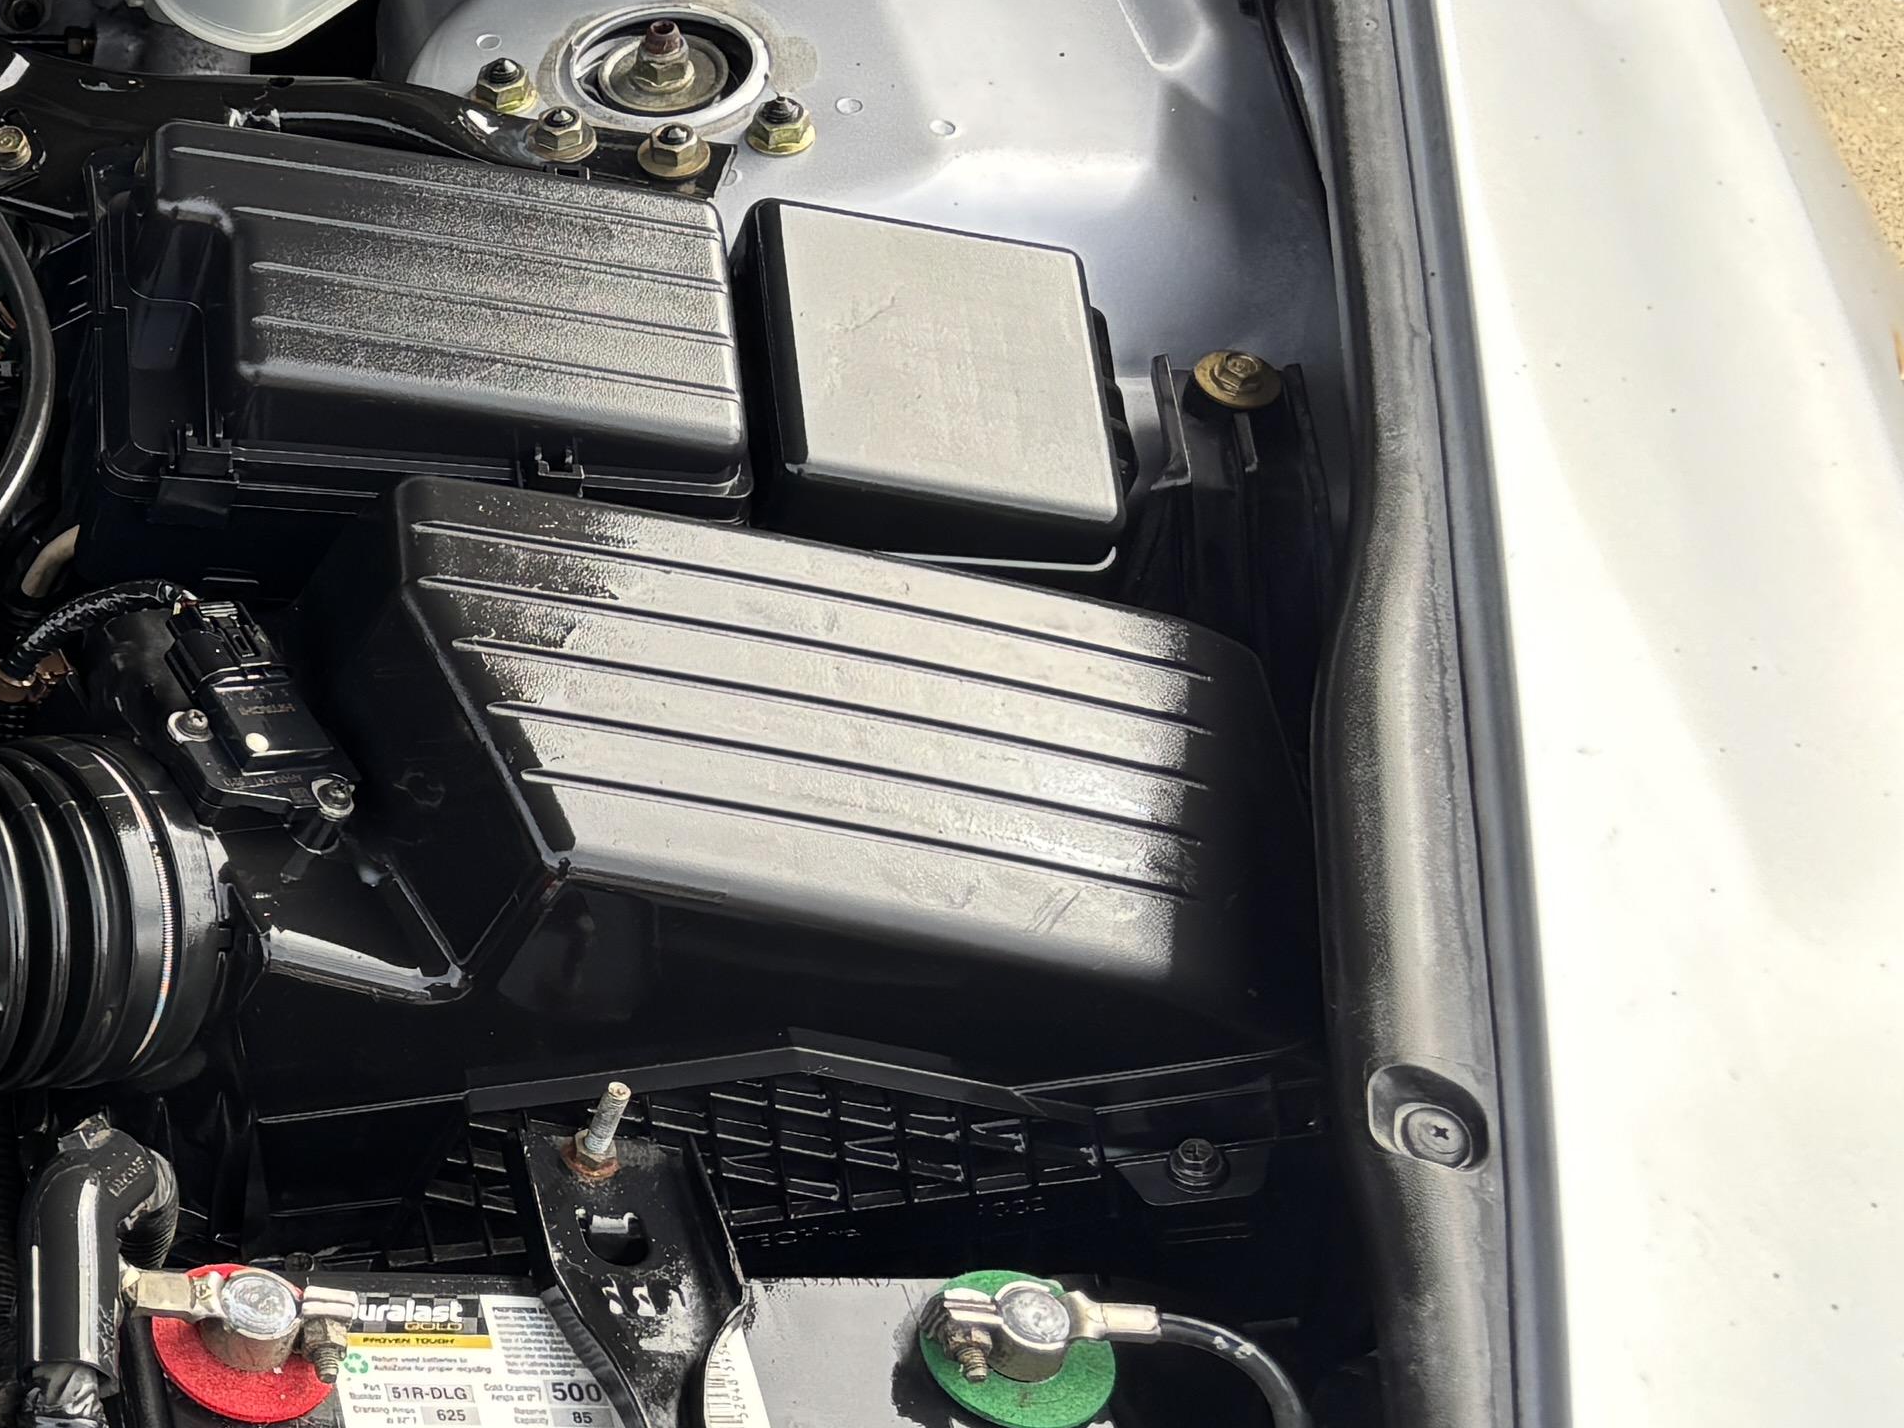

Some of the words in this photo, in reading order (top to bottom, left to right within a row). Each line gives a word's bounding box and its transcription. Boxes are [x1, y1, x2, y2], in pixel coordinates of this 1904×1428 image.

[353, 1299, 464, 1323] uralast
[404, 1321, 463, 1333] GOLD
[362, 1336, 411, 1346] PROVEN
[415, 1336, 455, 1346] TOUGH
[391, 1385, 468, 1401] 51R-DLG
[551, 1382, 602, 1403] 500
[436, 1409, 467, 1422] 625
[572, 1412, 593, 1424] 85
